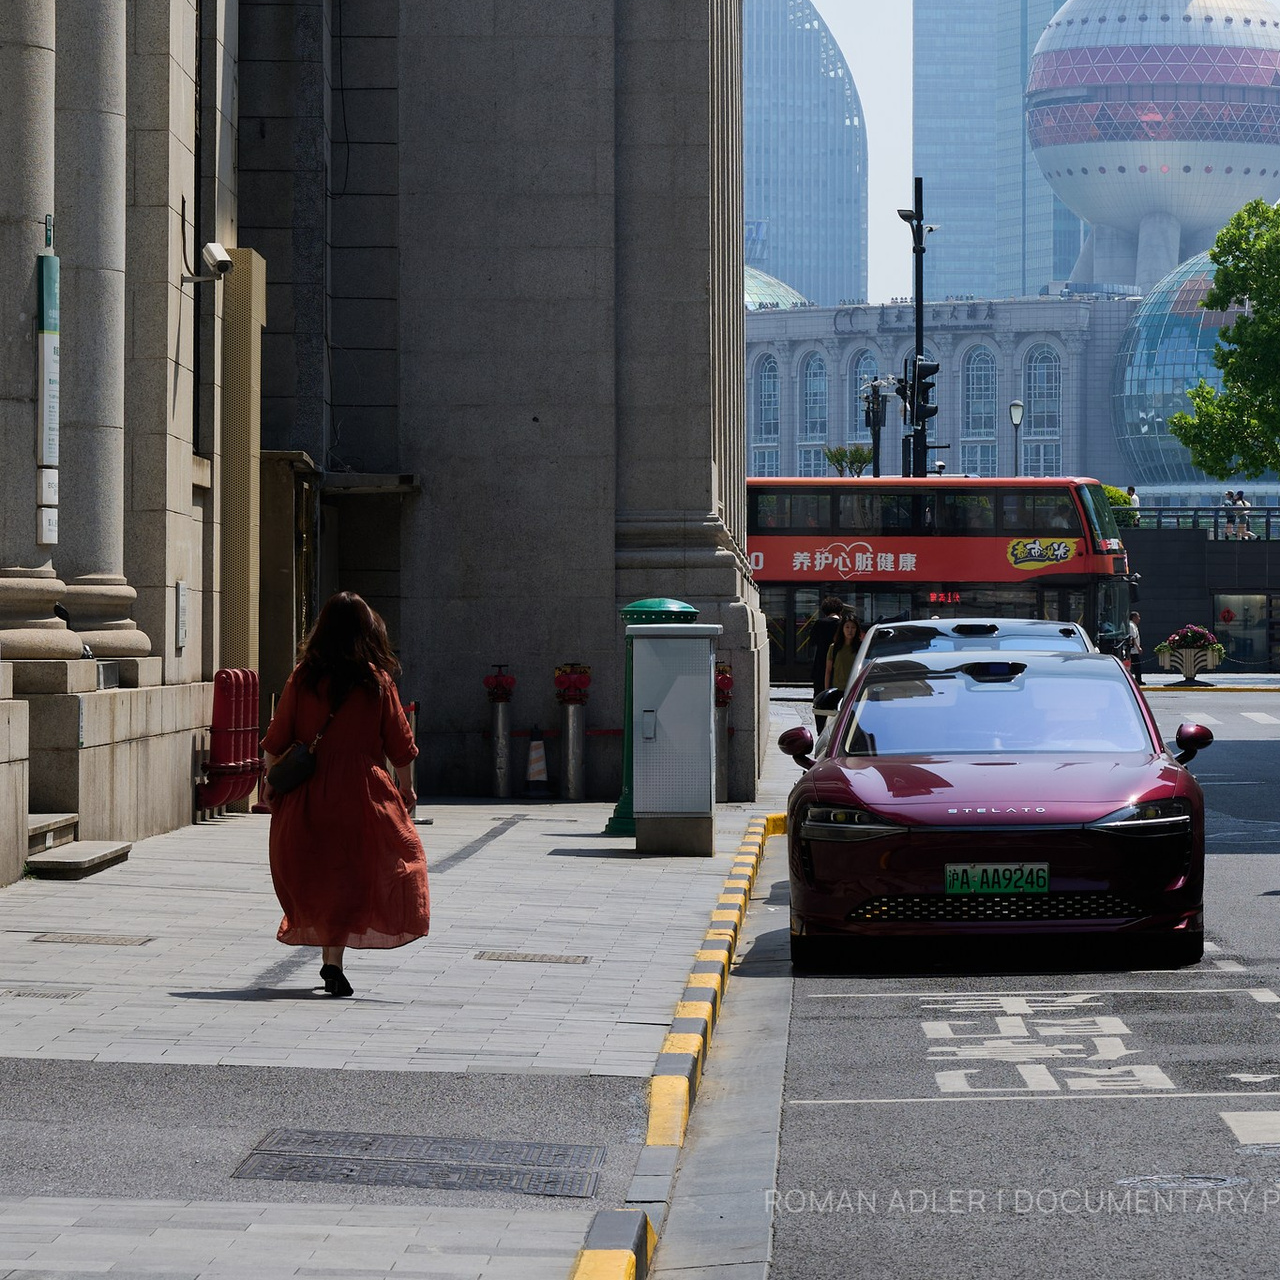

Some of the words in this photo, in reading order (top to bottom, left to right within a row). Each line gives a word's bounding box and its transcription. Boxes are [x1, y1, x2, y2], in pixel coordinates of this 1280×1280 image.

[792, 551, 917, 572] 养护心脏健康
[947, 807, 1046, 815] STELATO
